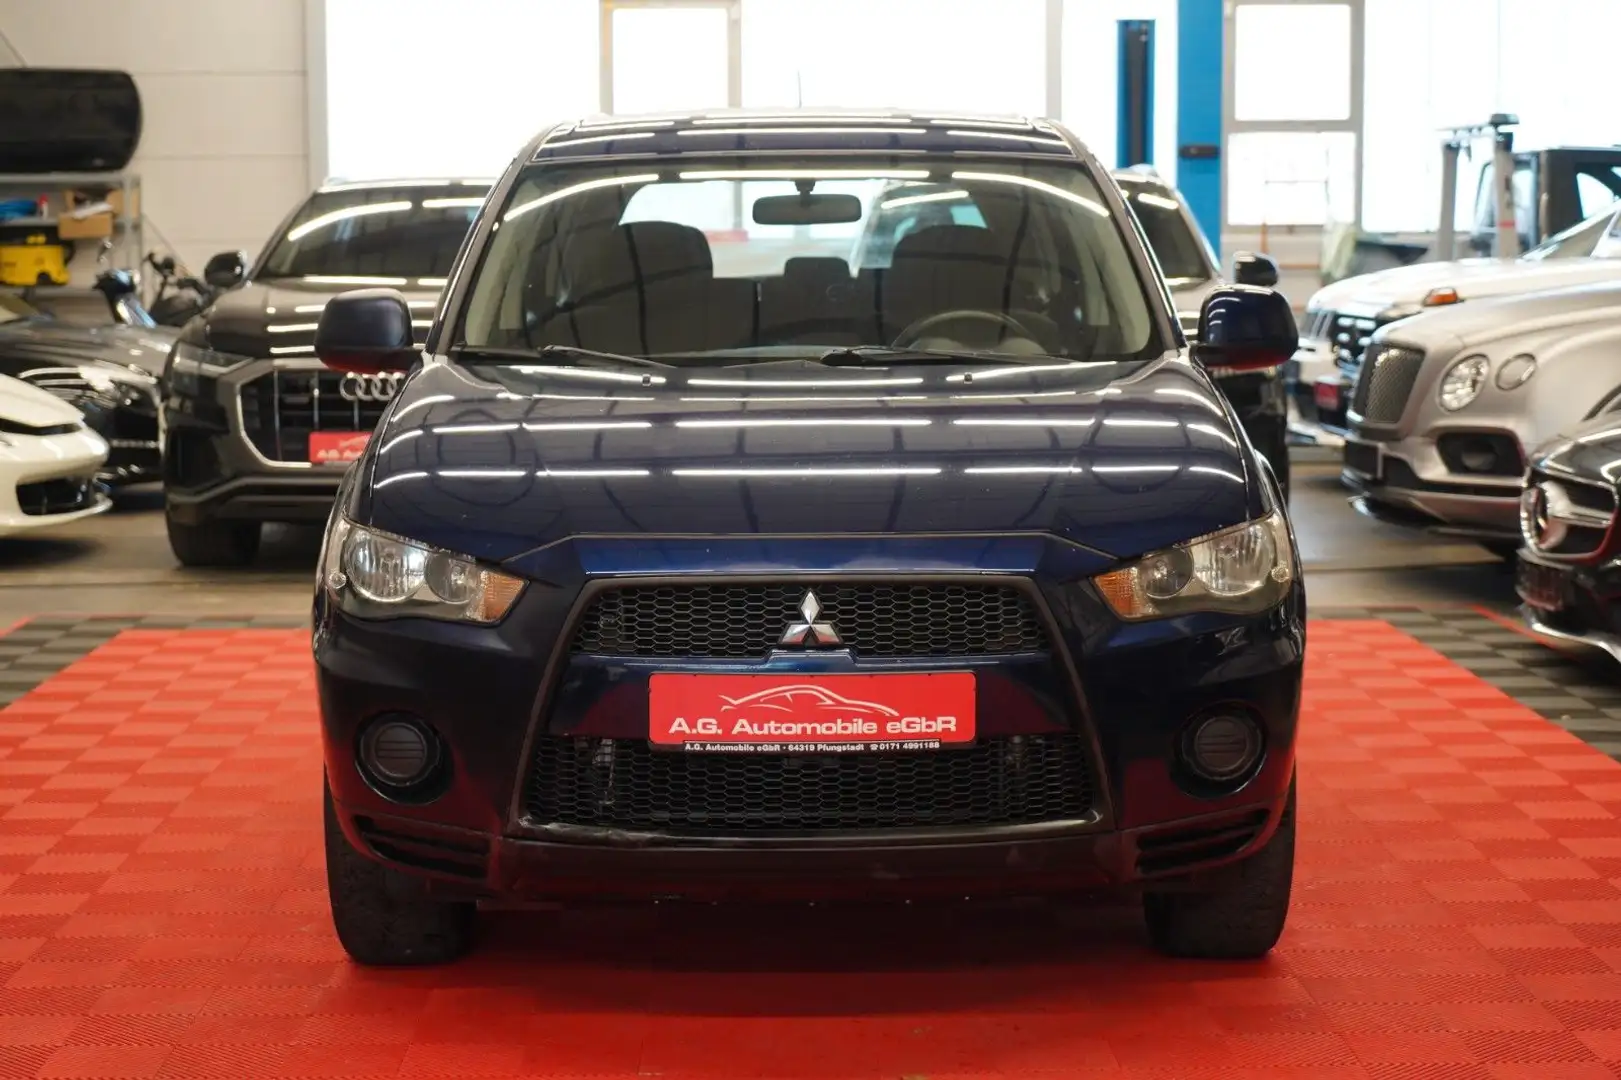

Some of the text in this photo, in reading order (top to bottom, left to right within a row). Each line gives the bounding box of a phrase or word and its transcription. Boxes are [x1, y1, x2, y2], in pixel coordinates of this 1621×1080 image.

[668, 716, 957, 735] A.G. Automobile eGbR
[685, 743, 704, 751] A.G.
[705, 744, 755, 752] Automobile
[756, 744, 780, 752] eGbR
[788, 744, 815, 752] 64319
[817, 743, 865, 752] Pfungstadt
